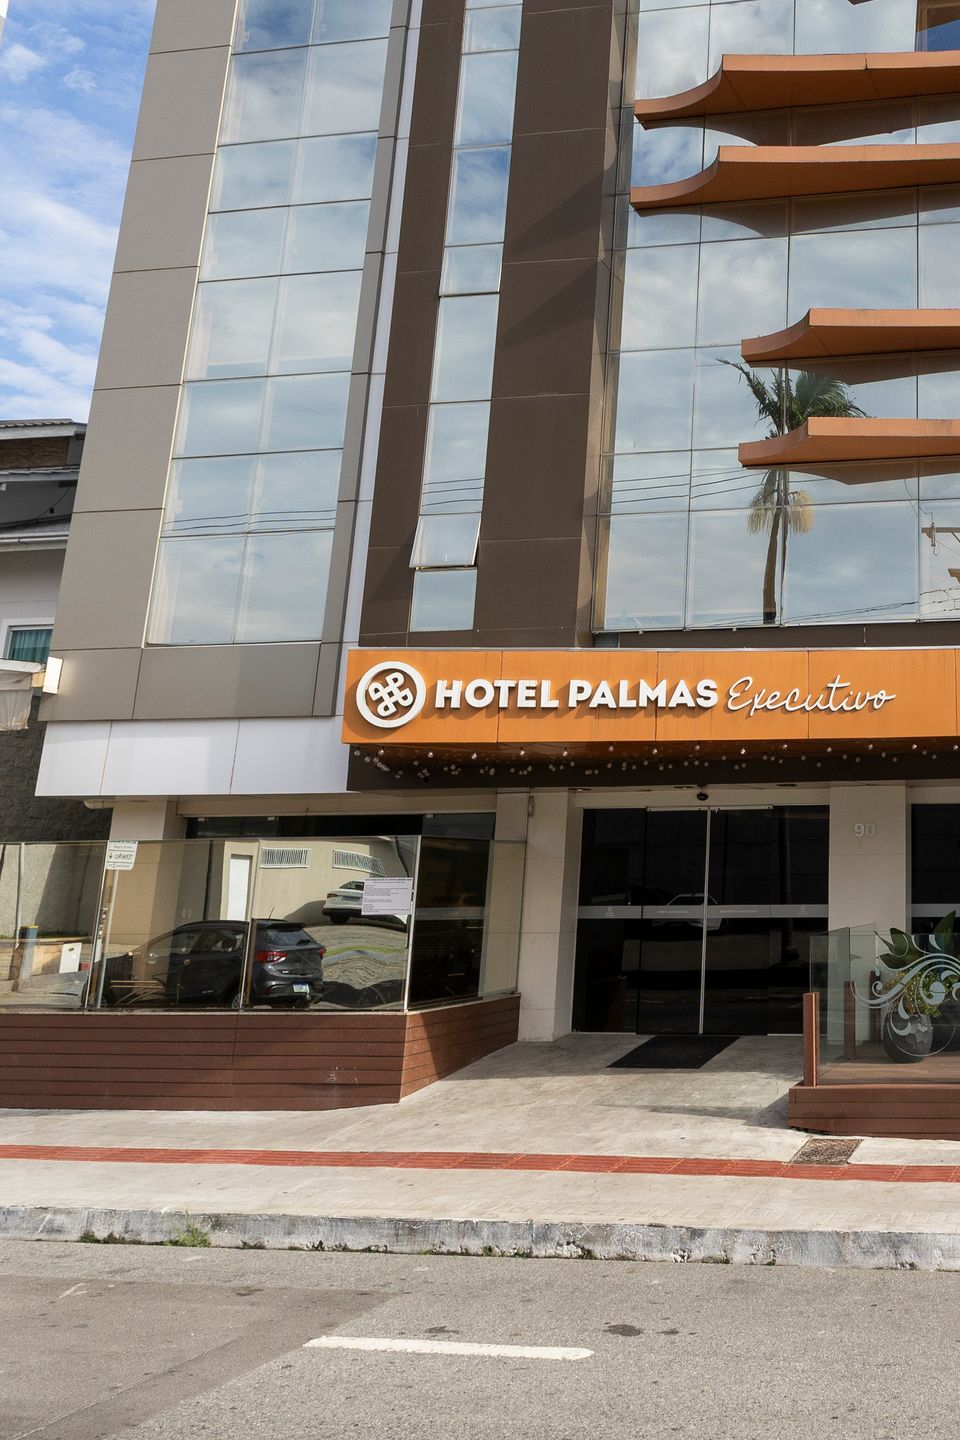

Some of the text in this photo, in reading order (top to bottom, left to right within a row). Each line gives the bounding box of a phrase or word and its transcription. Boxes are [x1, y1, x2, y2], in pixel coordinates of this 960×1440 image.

[435, 675, 896, 716] HOTEL PALMAS Executivo
[854, 823, 876, 838] 90
